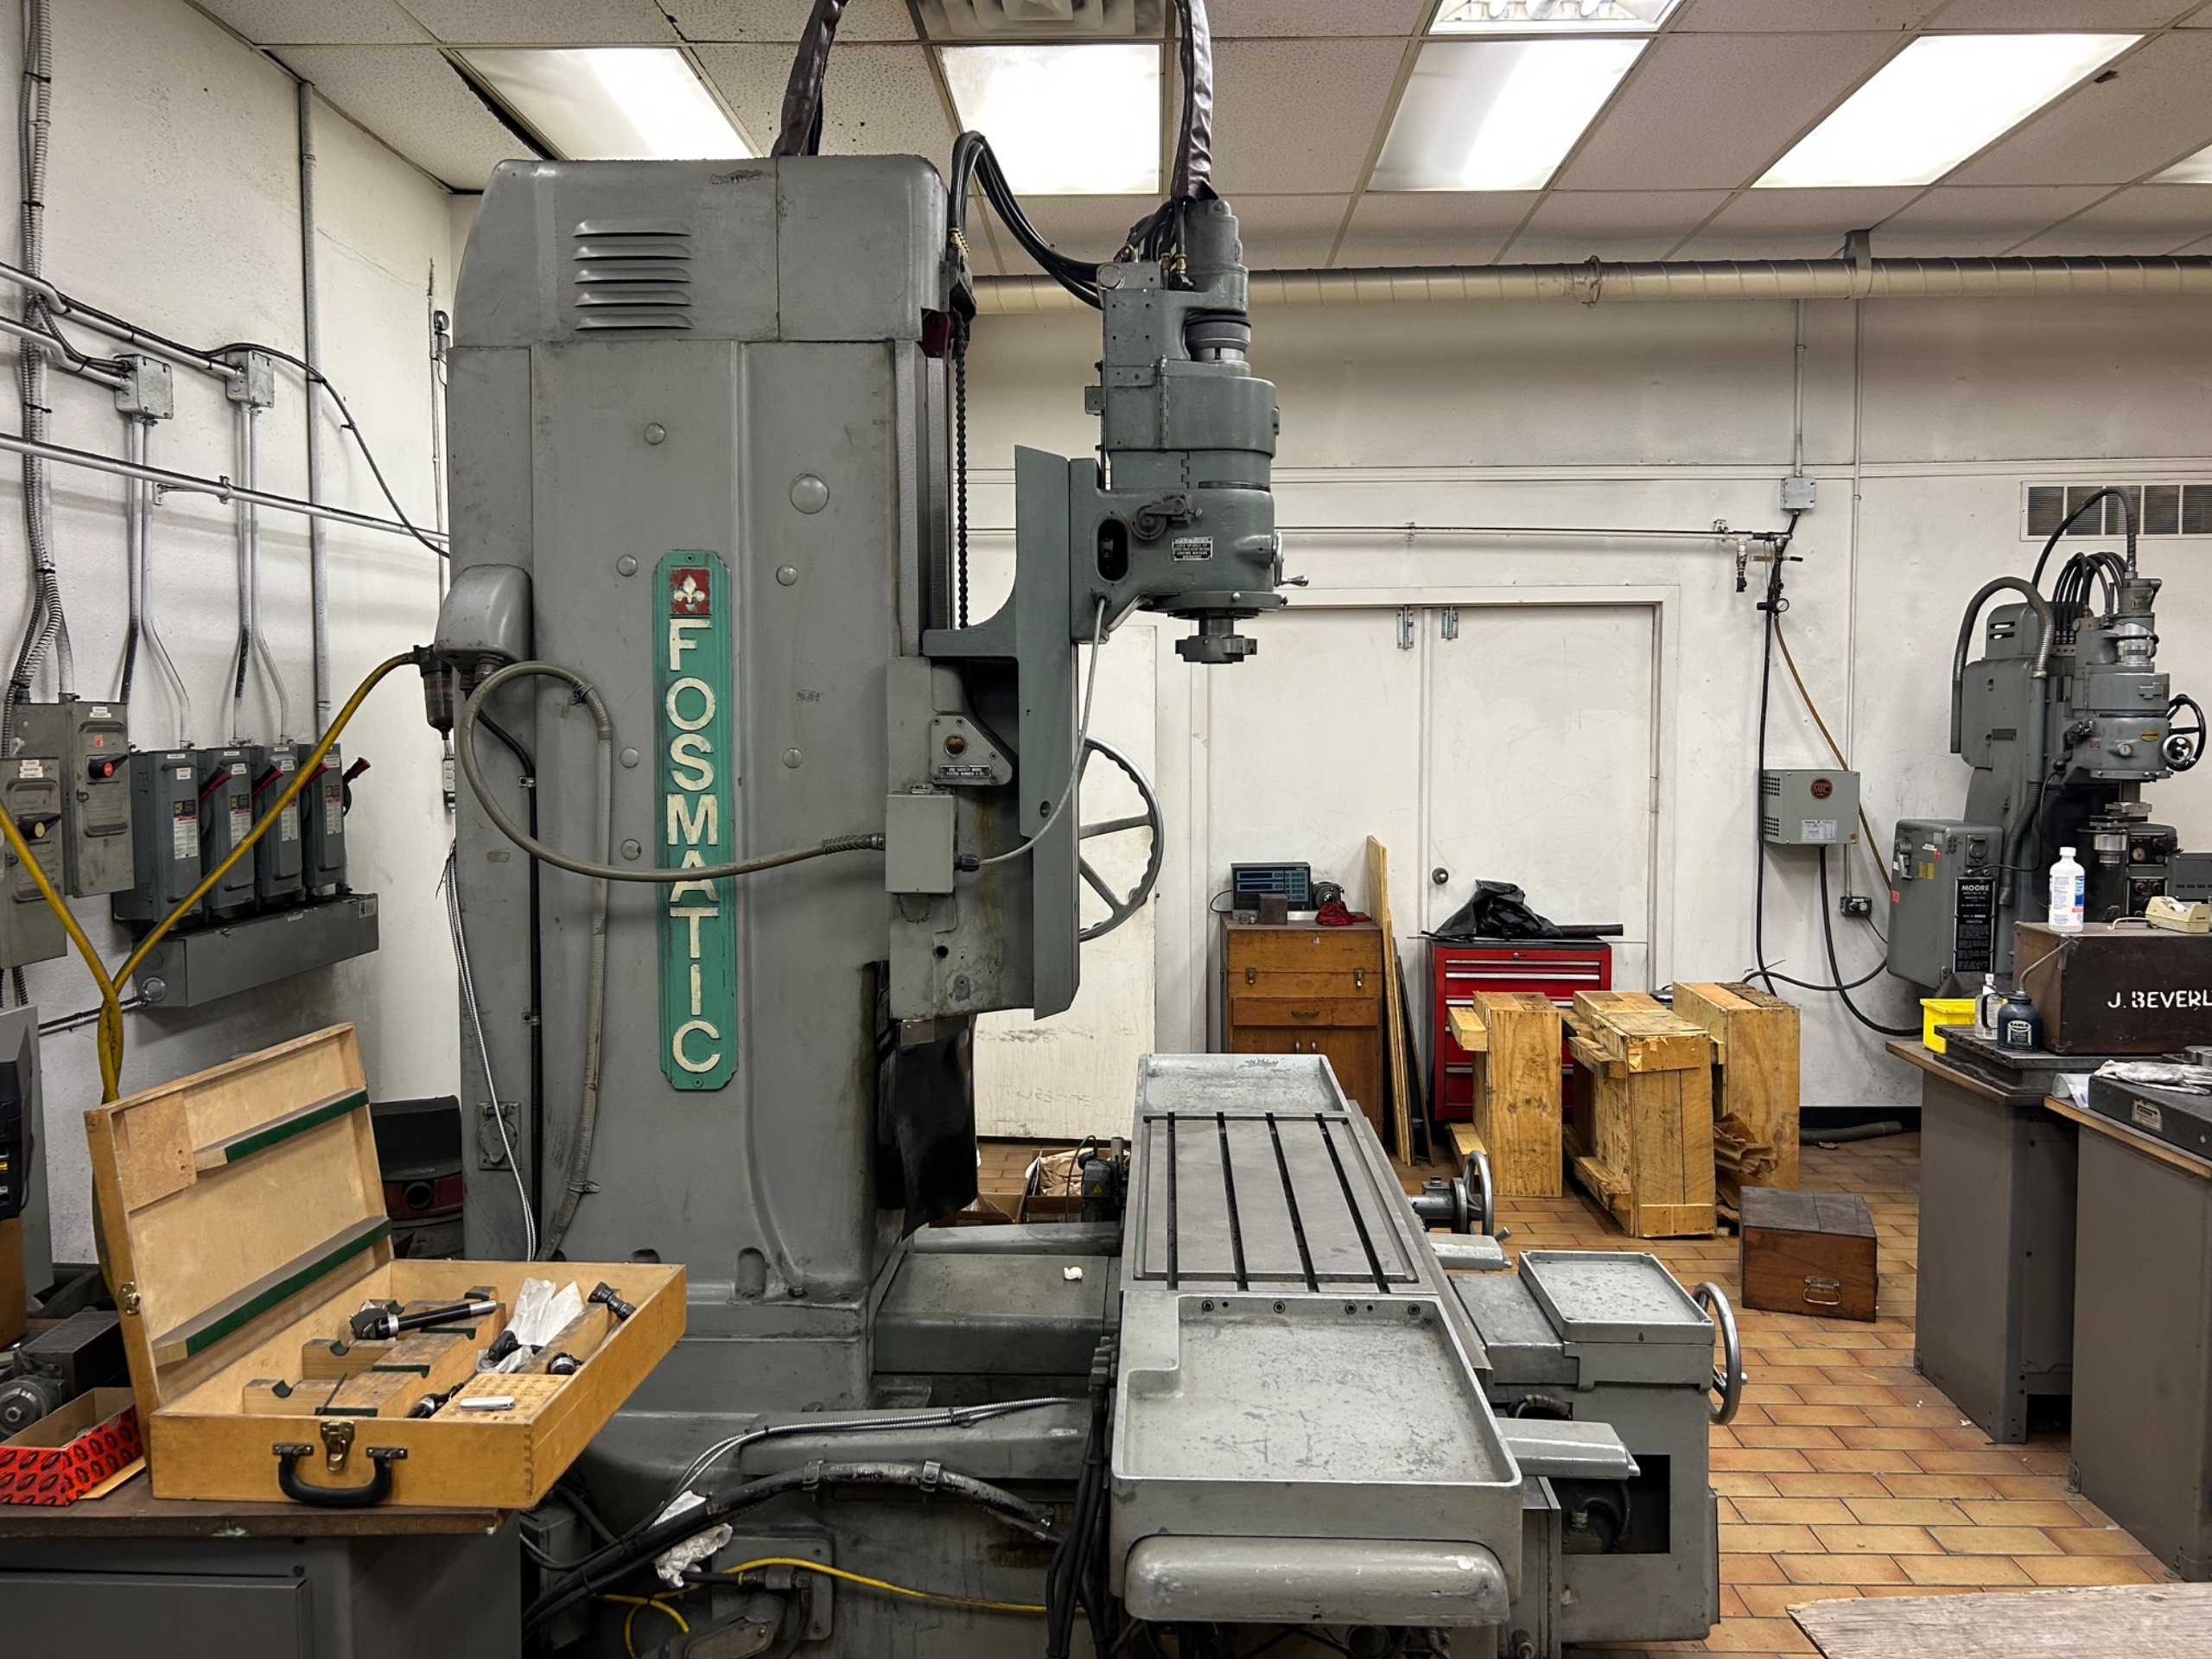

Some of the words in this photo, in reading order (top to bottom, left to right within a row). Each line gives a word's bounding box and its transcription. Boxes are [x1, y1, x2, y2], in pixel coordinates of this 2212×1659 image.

[665, 618, 722, 1073] FOSMATIC
[2107, 991, 2126, 1008] J.
[2131, 989, 2212, 1008] BEVERL
